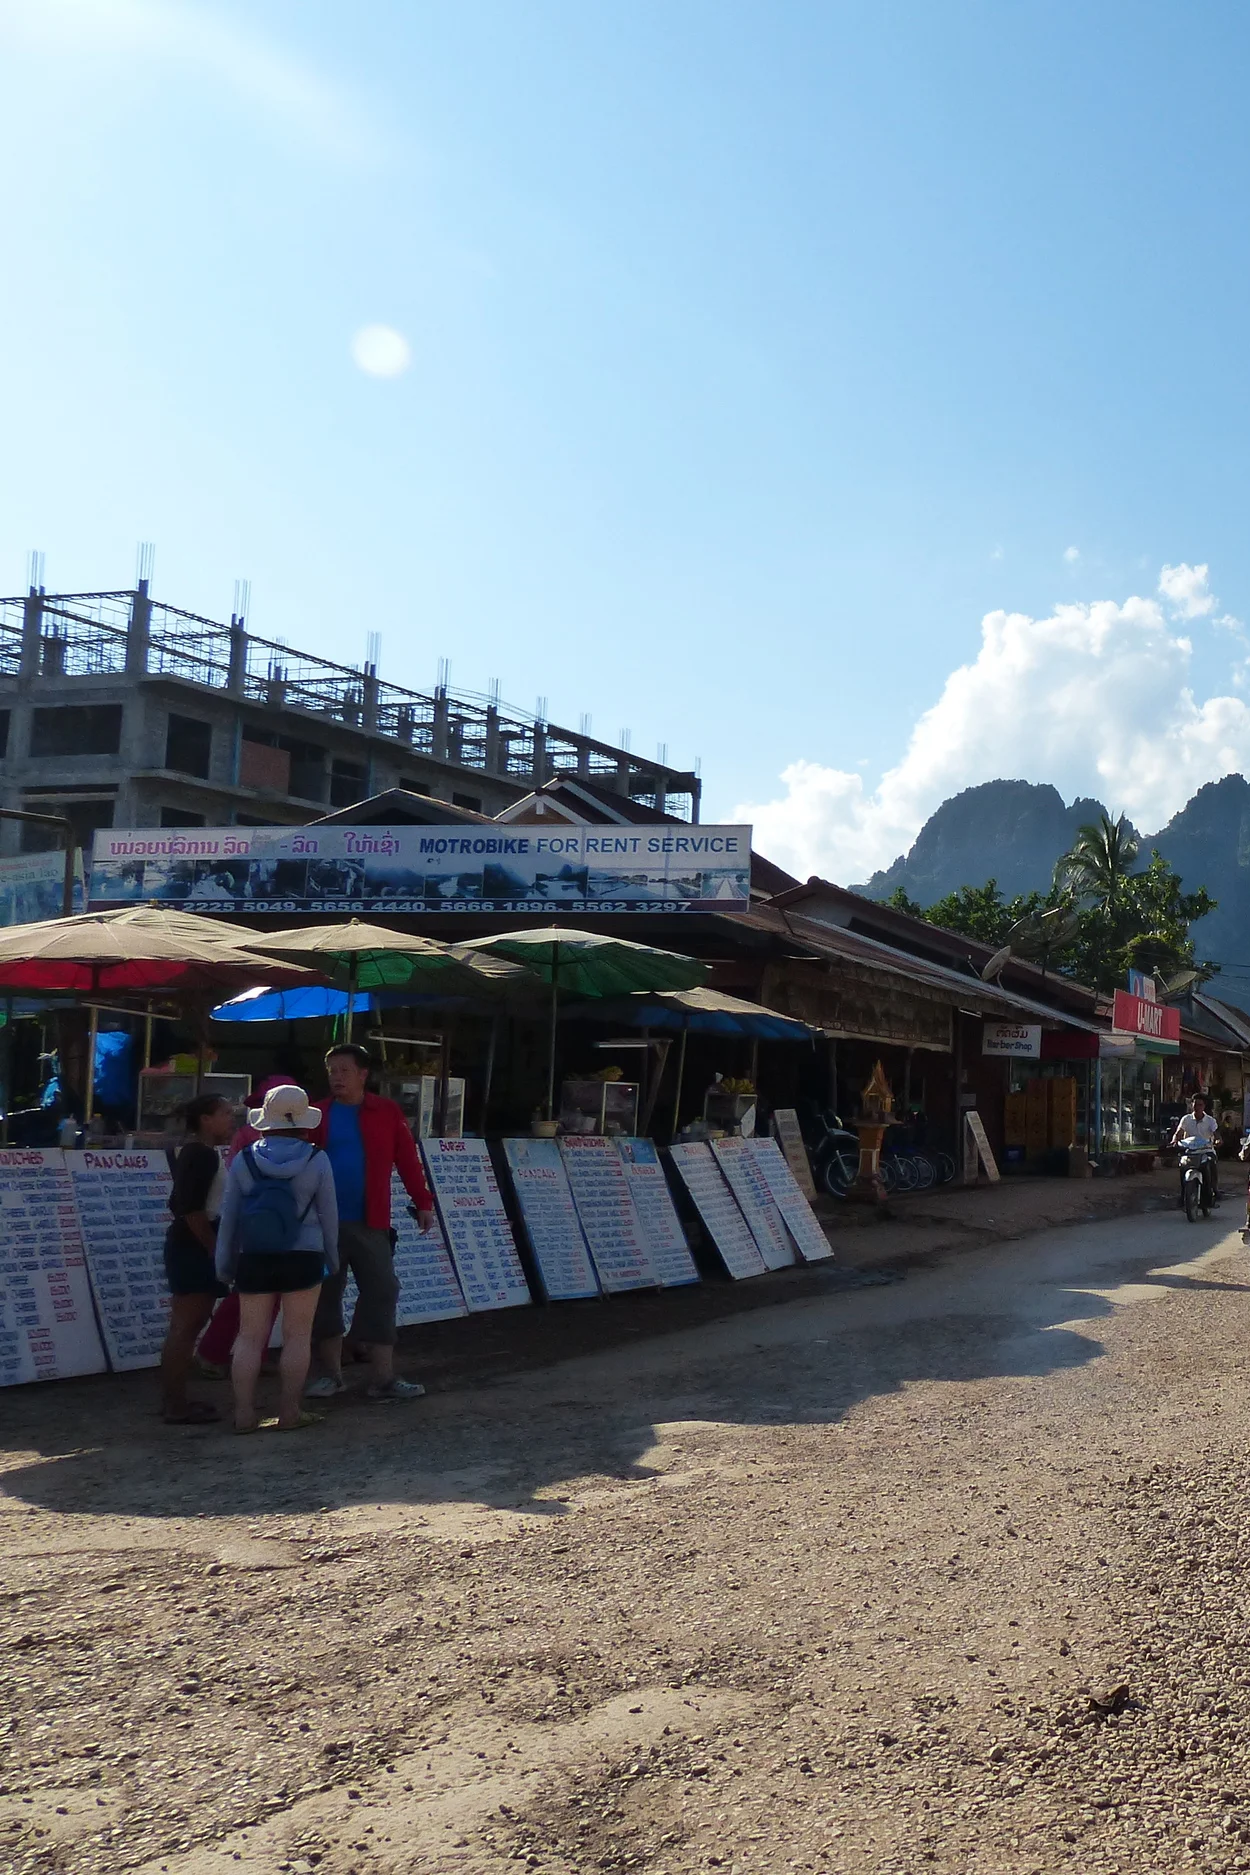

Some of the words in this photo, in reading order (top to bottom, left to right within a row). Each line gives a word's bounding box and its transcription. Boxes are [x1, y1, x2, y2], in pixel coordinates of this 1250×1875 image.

[419, 838, 529, 854] MOTROBIKE
[537, 838, 580, 854] FOR
[586, 838, 641, 853] RENT
[647, 837, 738, 853] SERVICE
[182, 901, 235, 913] 2225
[310, 901, 367, 912] 5656
[440, 901, 495, 912] 5666
[572, 901, 629, 912] 5562
[635, 901, 691, 912] 3297
[1137, 1001, 1163, 1036] U-MART
[987, 1040, 1015, 1050] Barber
[1015, 1042, 1032, 1053] Shop
[439, 1140, 466, 1152] BURGER
